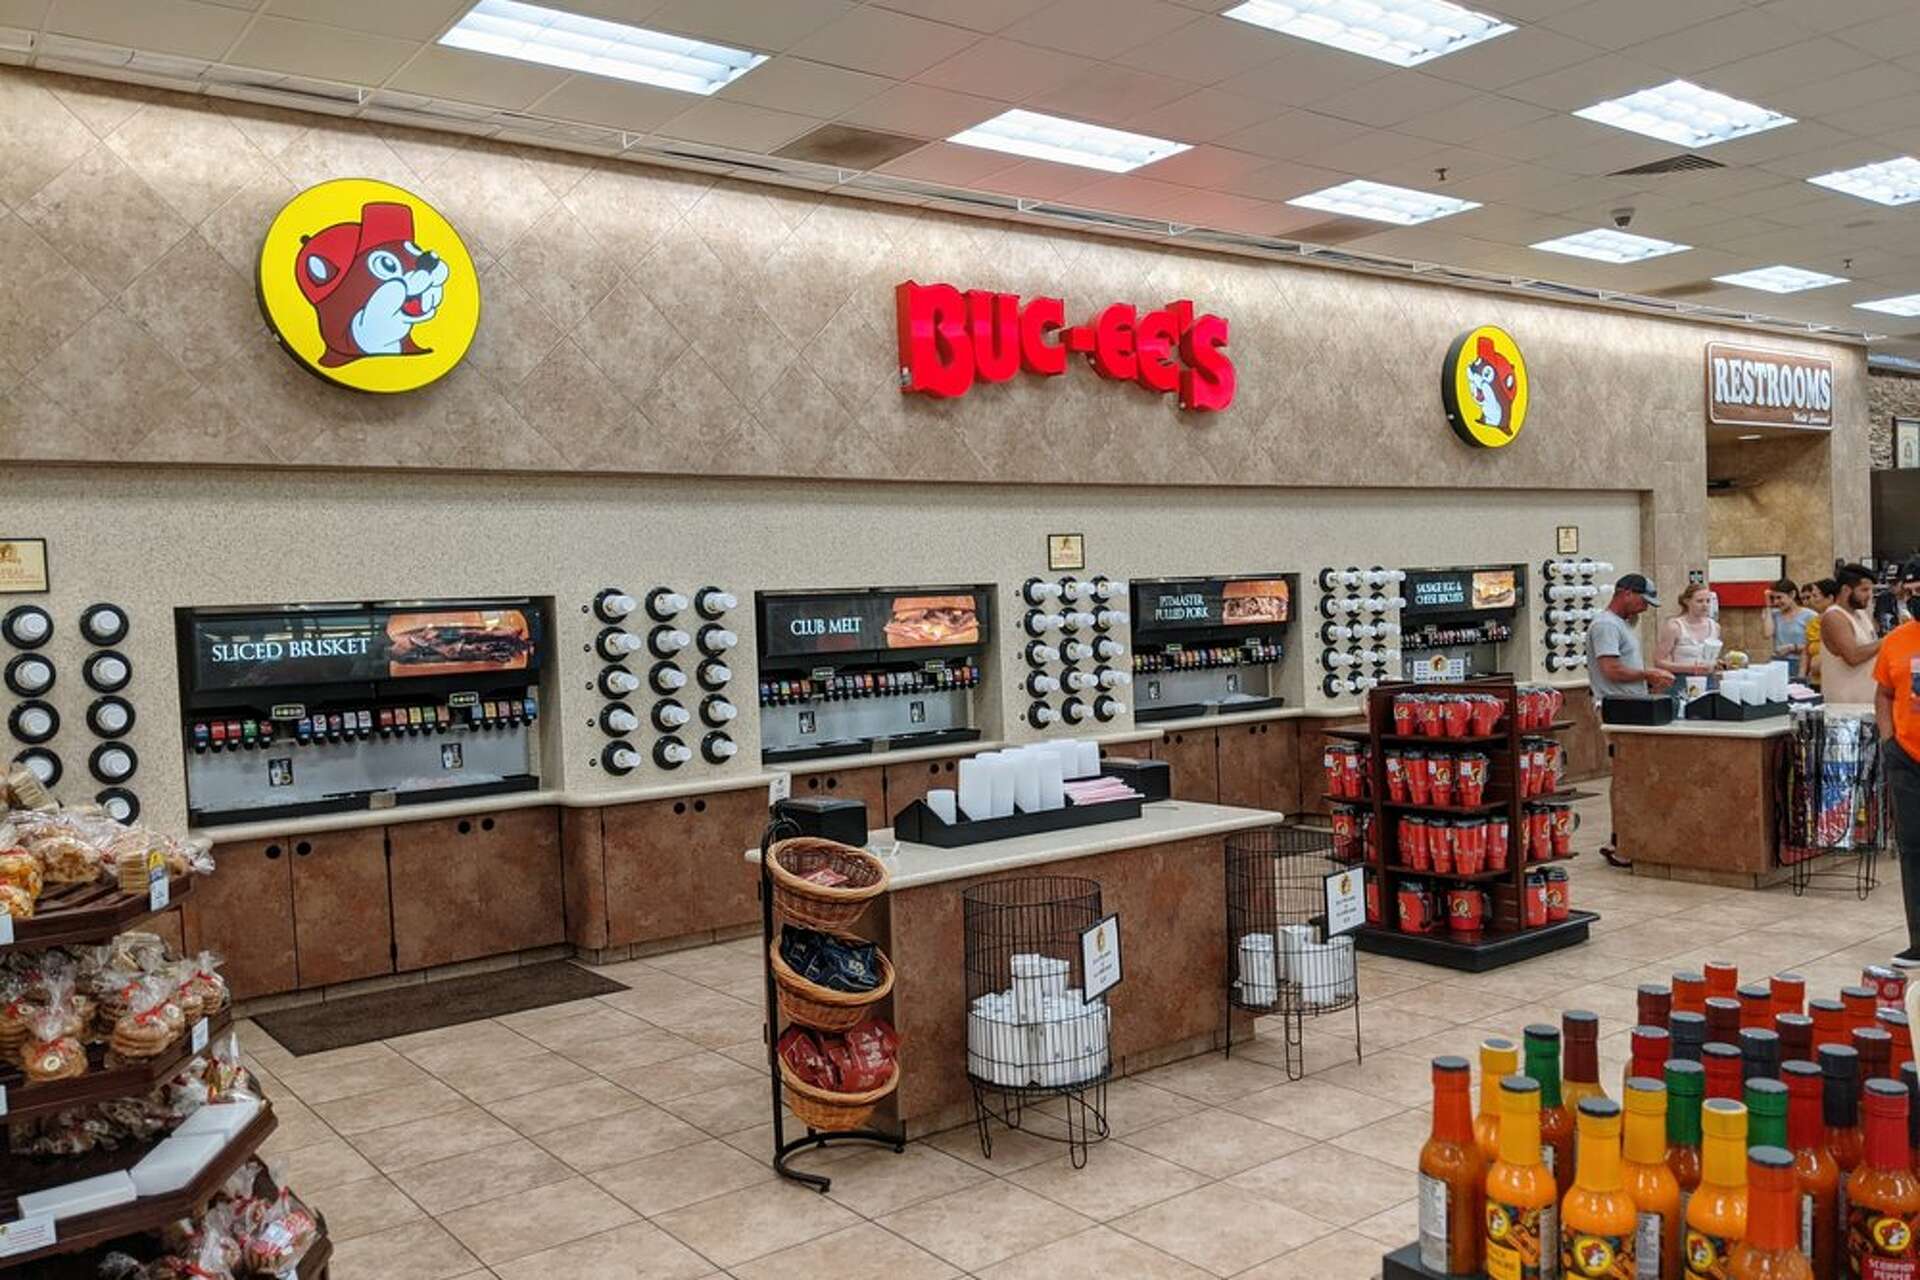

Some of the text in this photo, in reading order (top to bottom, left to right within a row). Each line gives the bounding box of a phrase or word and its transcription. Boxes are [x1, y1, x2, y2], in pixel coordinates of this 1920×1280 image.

[1713, 357, 1832, 411] RESTROOMS
[1155, 607, 1210, 620] PULLED PORK
[790, 617, 863, 636] CLUB MELT
[212, 638, 371, 662] SLICED BRISKET
